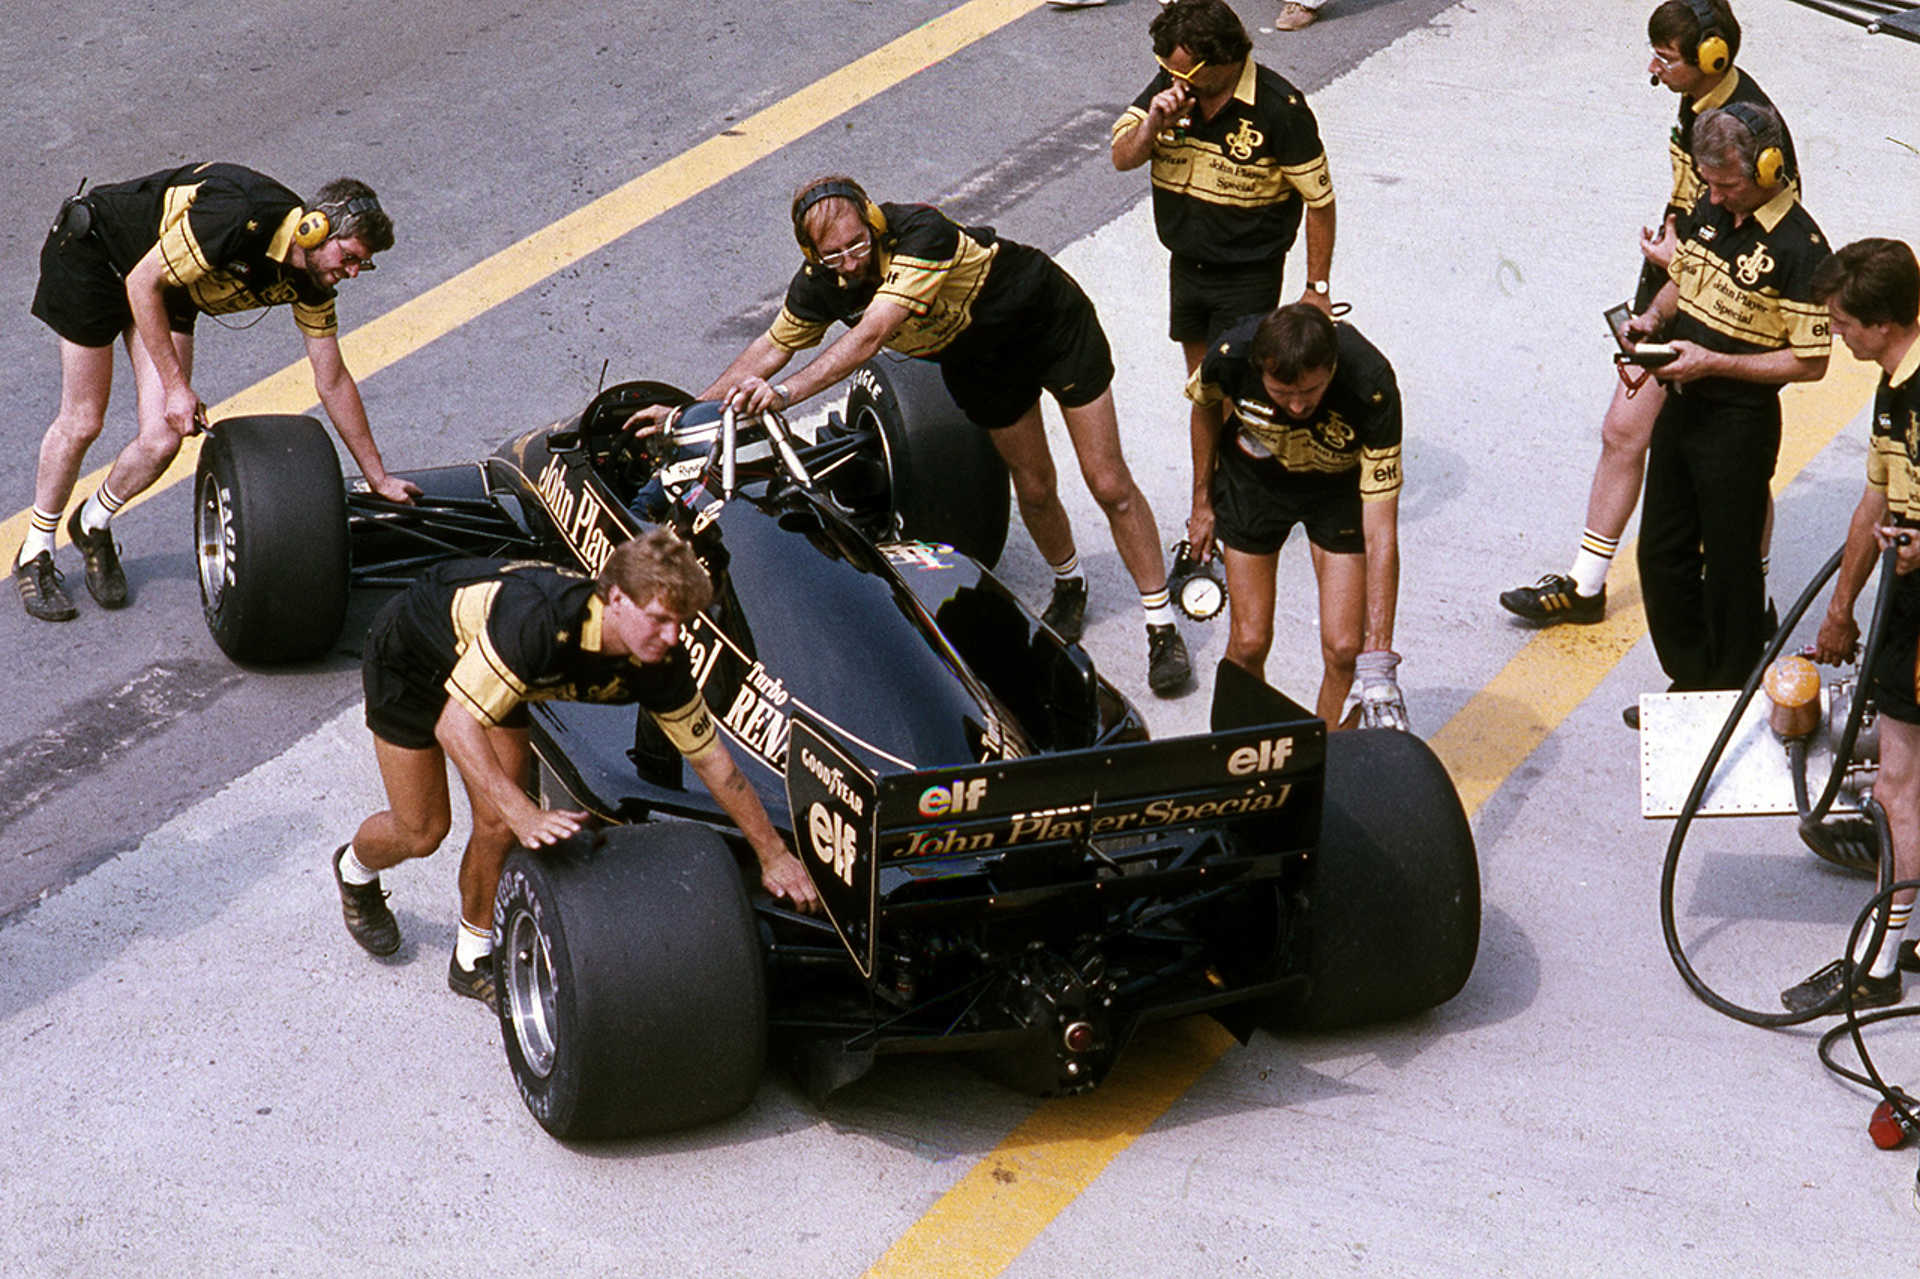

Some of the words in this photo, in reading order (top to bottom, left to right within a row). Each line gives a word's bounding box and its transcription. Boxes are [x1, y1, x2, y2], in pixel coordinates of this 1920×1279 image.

[1209, 158, 1233, 175] John
[1216, 177, 1256, 192] Special
[1713, 278, 1735, 299] John
[1735, 291, 1769, 313] Player
[1713, 299, 1754, 325] Special
[1812, 321, 1830, 337] el
[1373, 463, 1398, 481] elf
[538, 453, 575, 532] John
[746, 661, 789, 706] Turbo
[691, 712, 712, 737] elf
[722, 684, 790, 768] REN
[1227, 736, 1294, 776] elf
[801, 747, 864, 817] GOODYEAR
[918, 778, 988, 818] elf
[893, 827, 995, 857] John
[1007, 812, 1138, 846] Player
[1140, 783, 1293, 826] Special
[809, 801, 857, 888] elf
